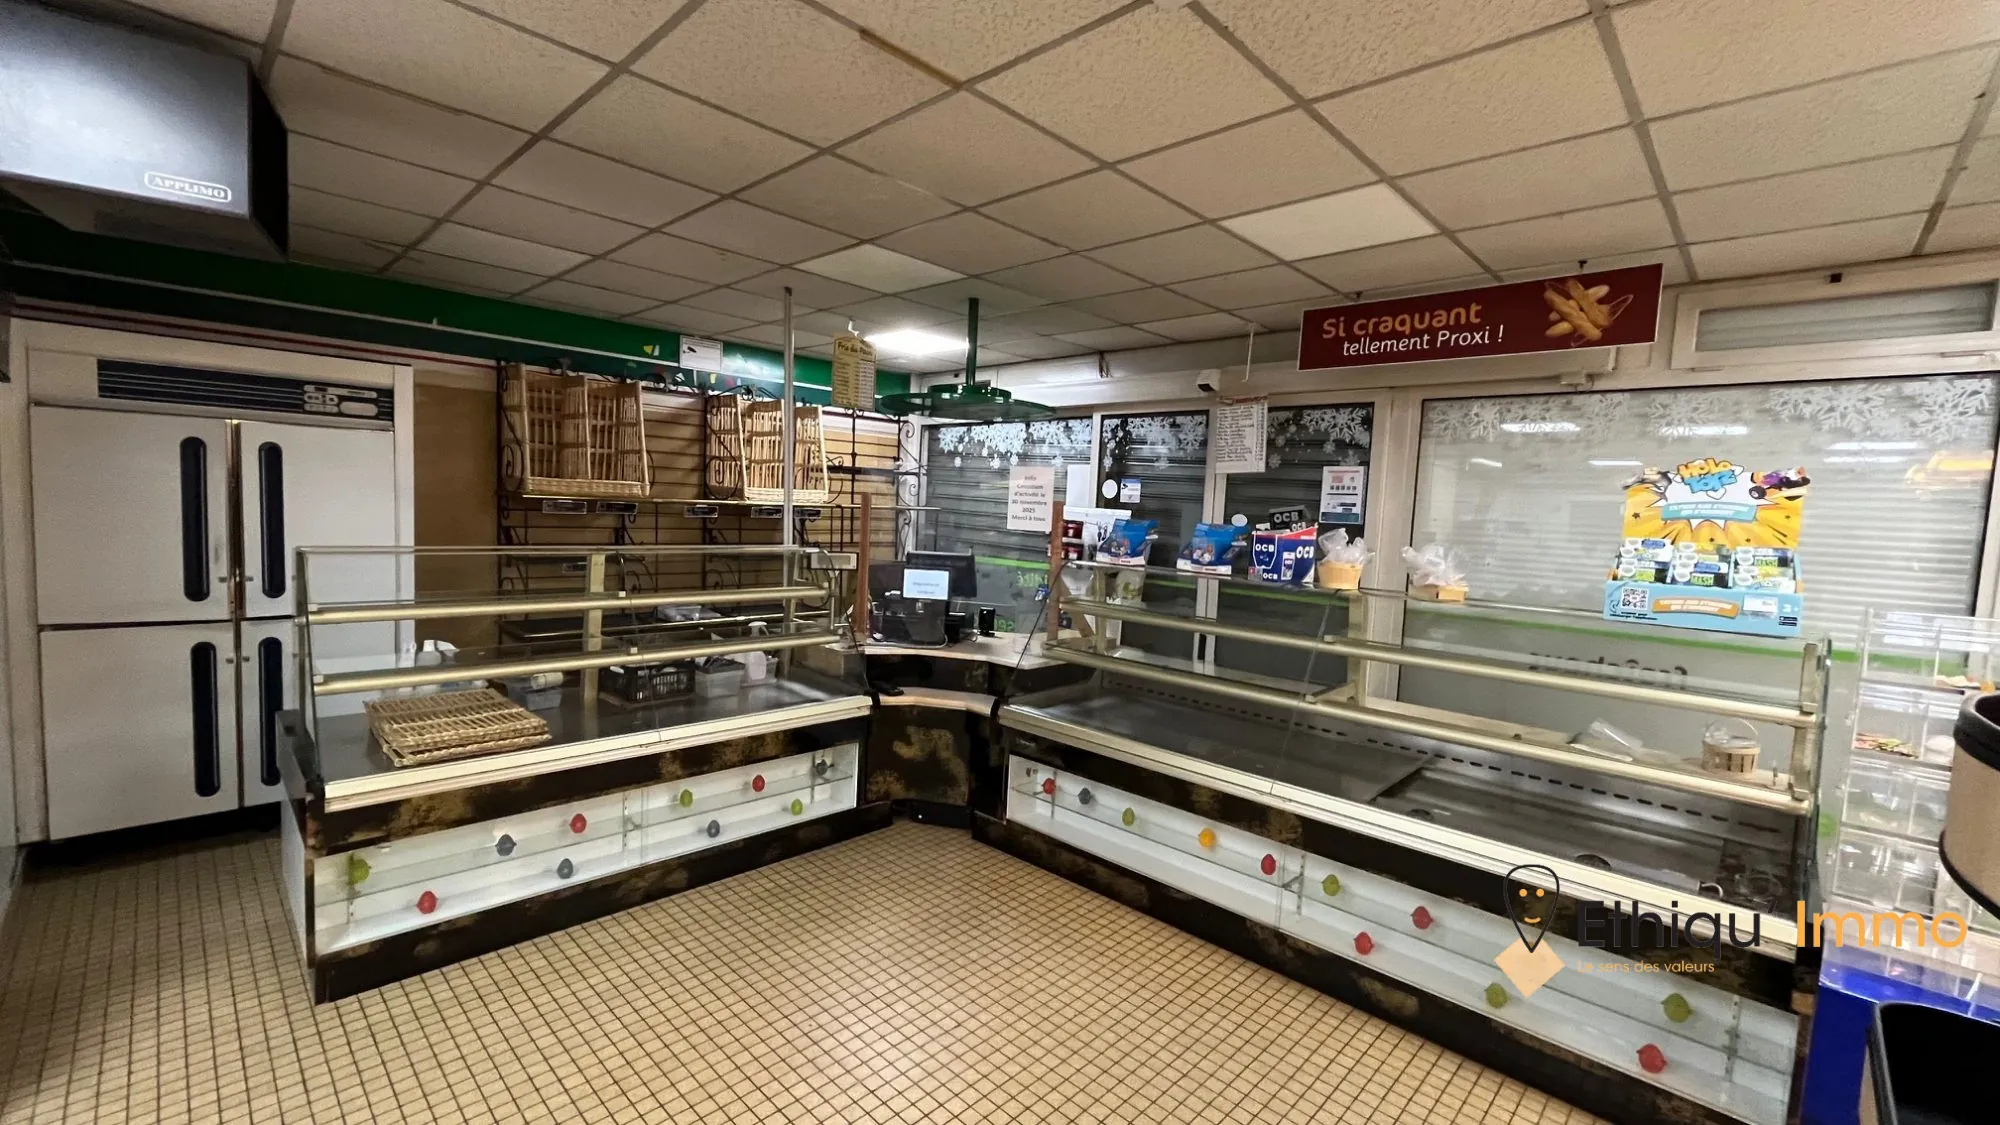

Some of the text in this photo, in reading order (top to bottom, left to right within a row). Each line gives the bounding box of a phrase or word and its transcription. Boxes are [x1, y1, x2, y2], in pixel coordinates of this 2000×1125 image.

[1322, 302, 1482, 339] Si craquant
[1343, 323, 1504, 356] tellement Proxi !
[1274, 511, 1300, 524] OCB
[1255, 543, 1275, 553] OCB
[1296, 545, 1315, 559] OCB
[1262, 572, 1278, 580] OCB
